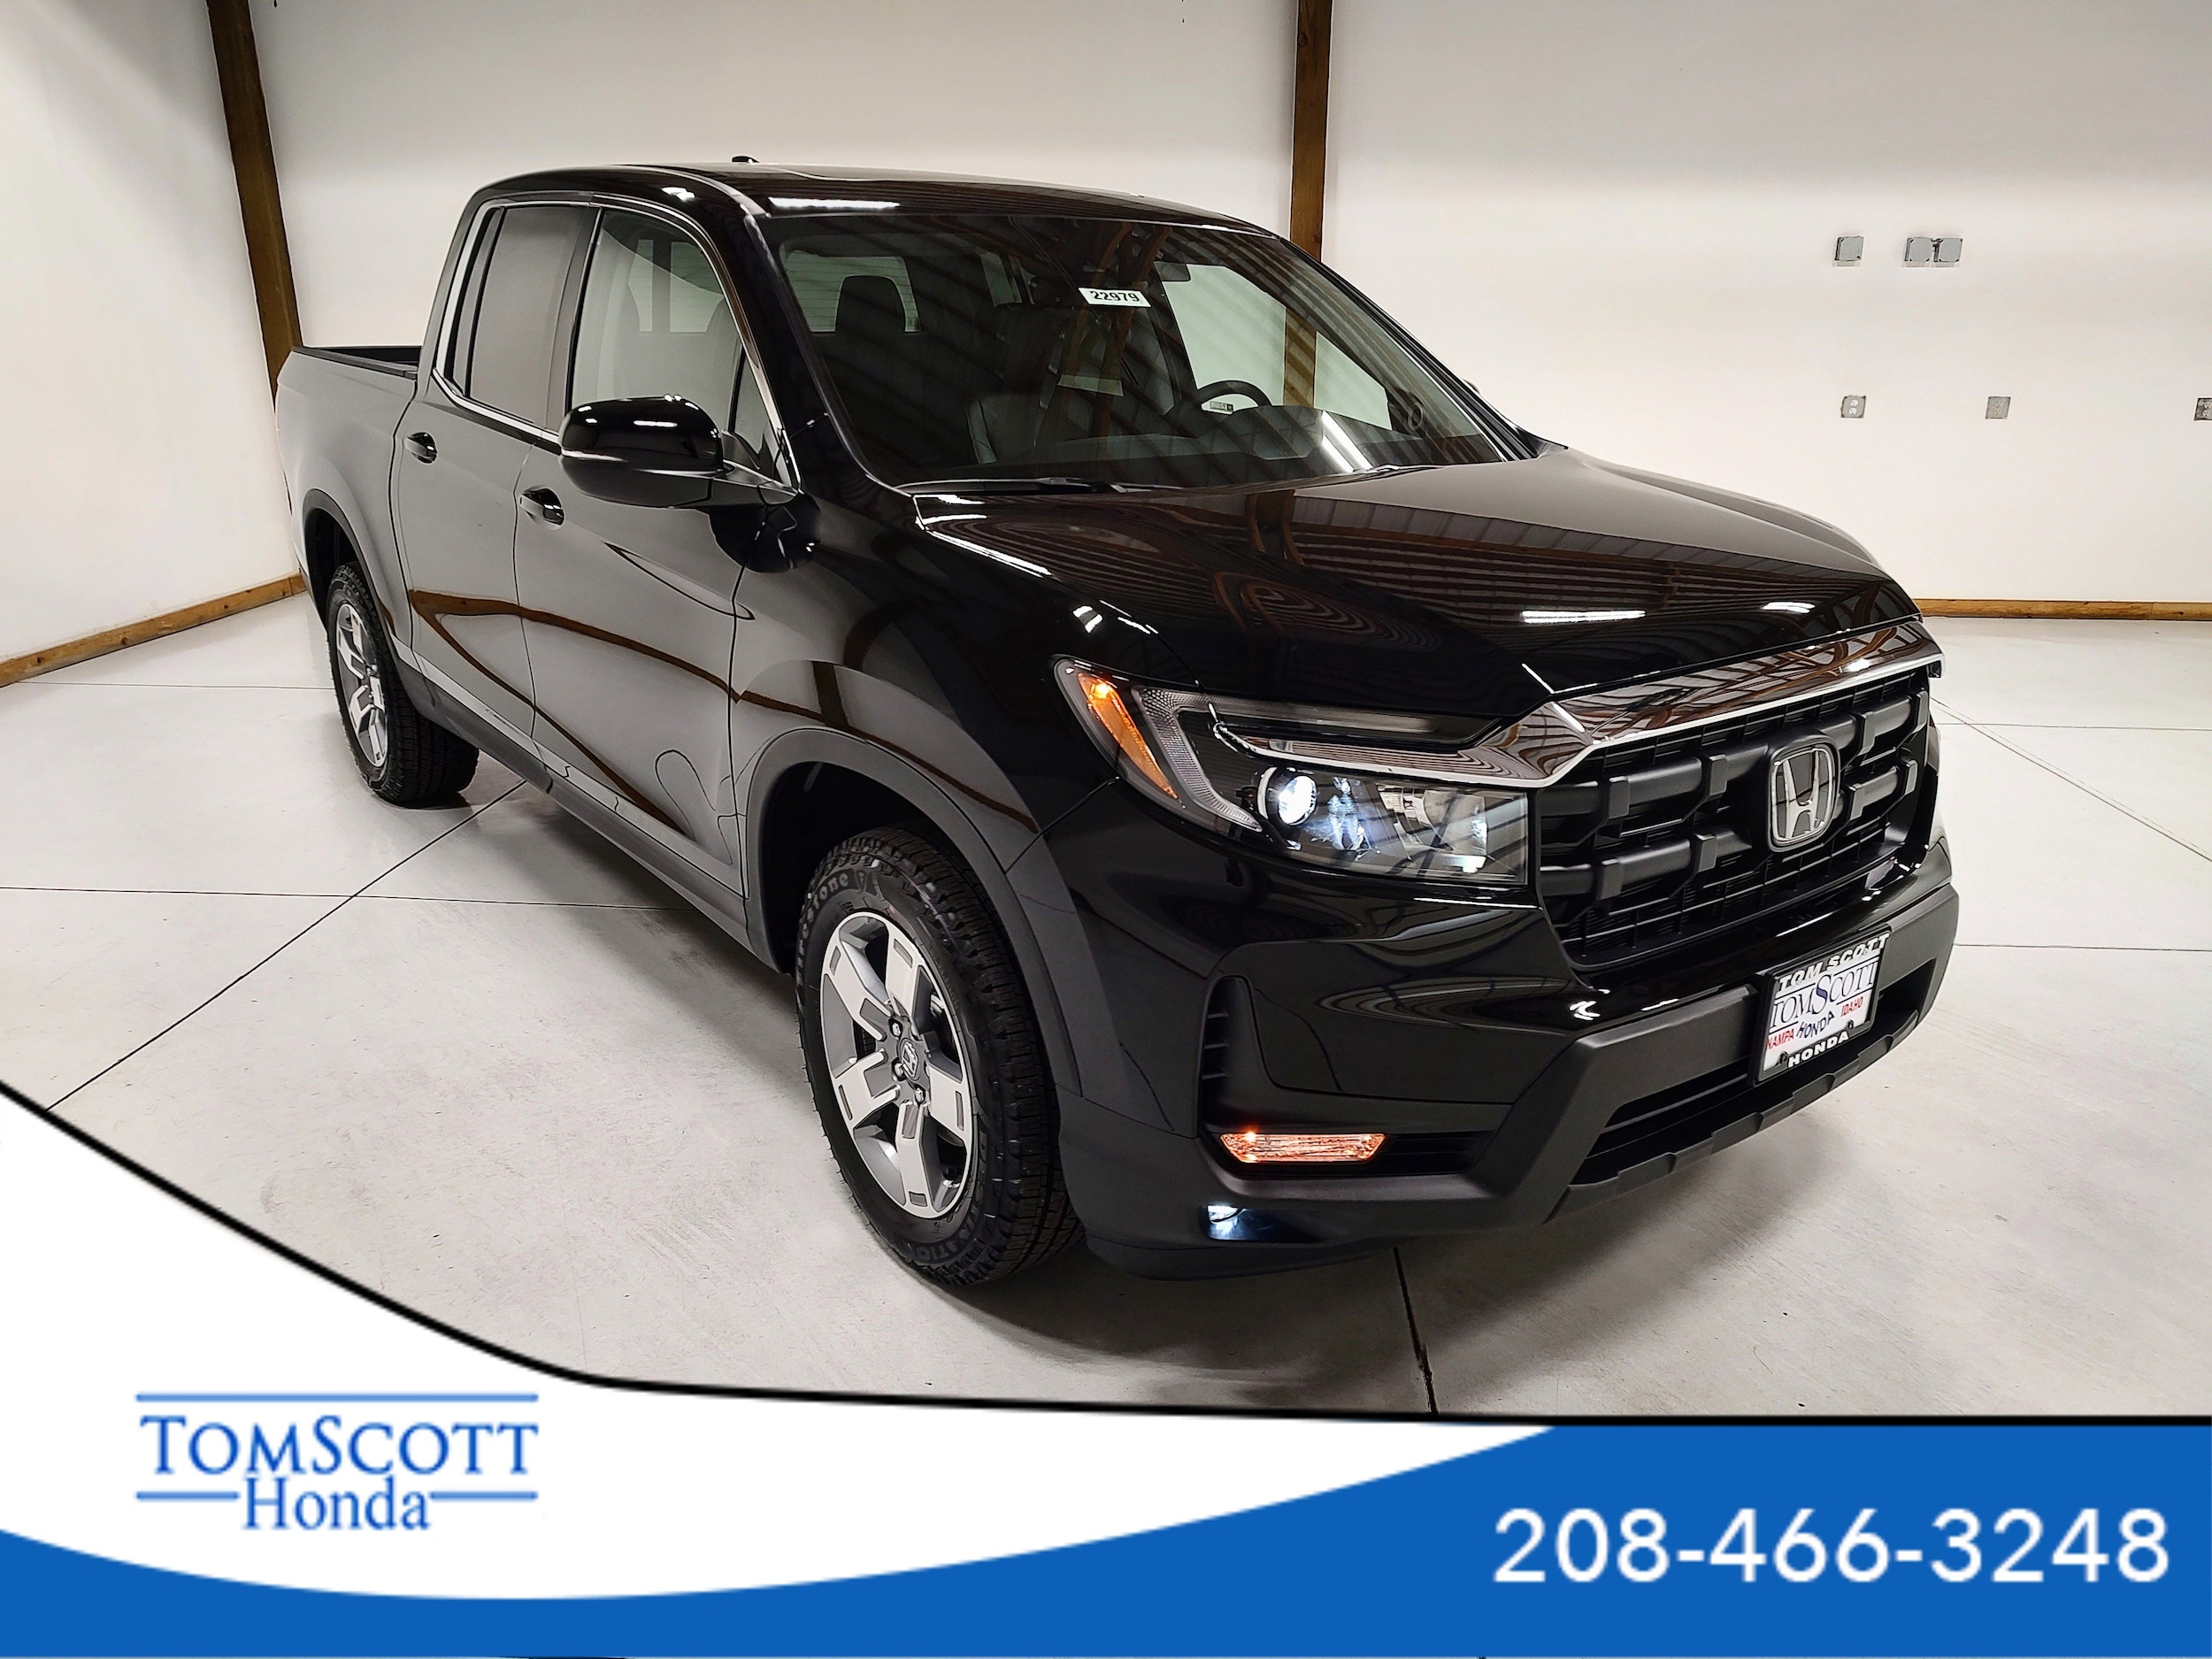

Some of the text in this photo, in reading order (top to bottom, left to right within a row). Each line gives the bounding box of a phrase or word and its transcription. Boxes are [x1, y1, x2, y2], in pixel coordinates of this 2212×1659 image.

[1089, 291, 1140, 302] 22979
[1779, 933, 1890, 992] TOM SCOTT
[1840, 996, 1863, 1017] IDAHO
[1797, 1010, 1835, 1039] HONDA
[1766, 1029, 1794, 1049] NAMPA
[1788, 1032, 1849, 1069] HONDA
